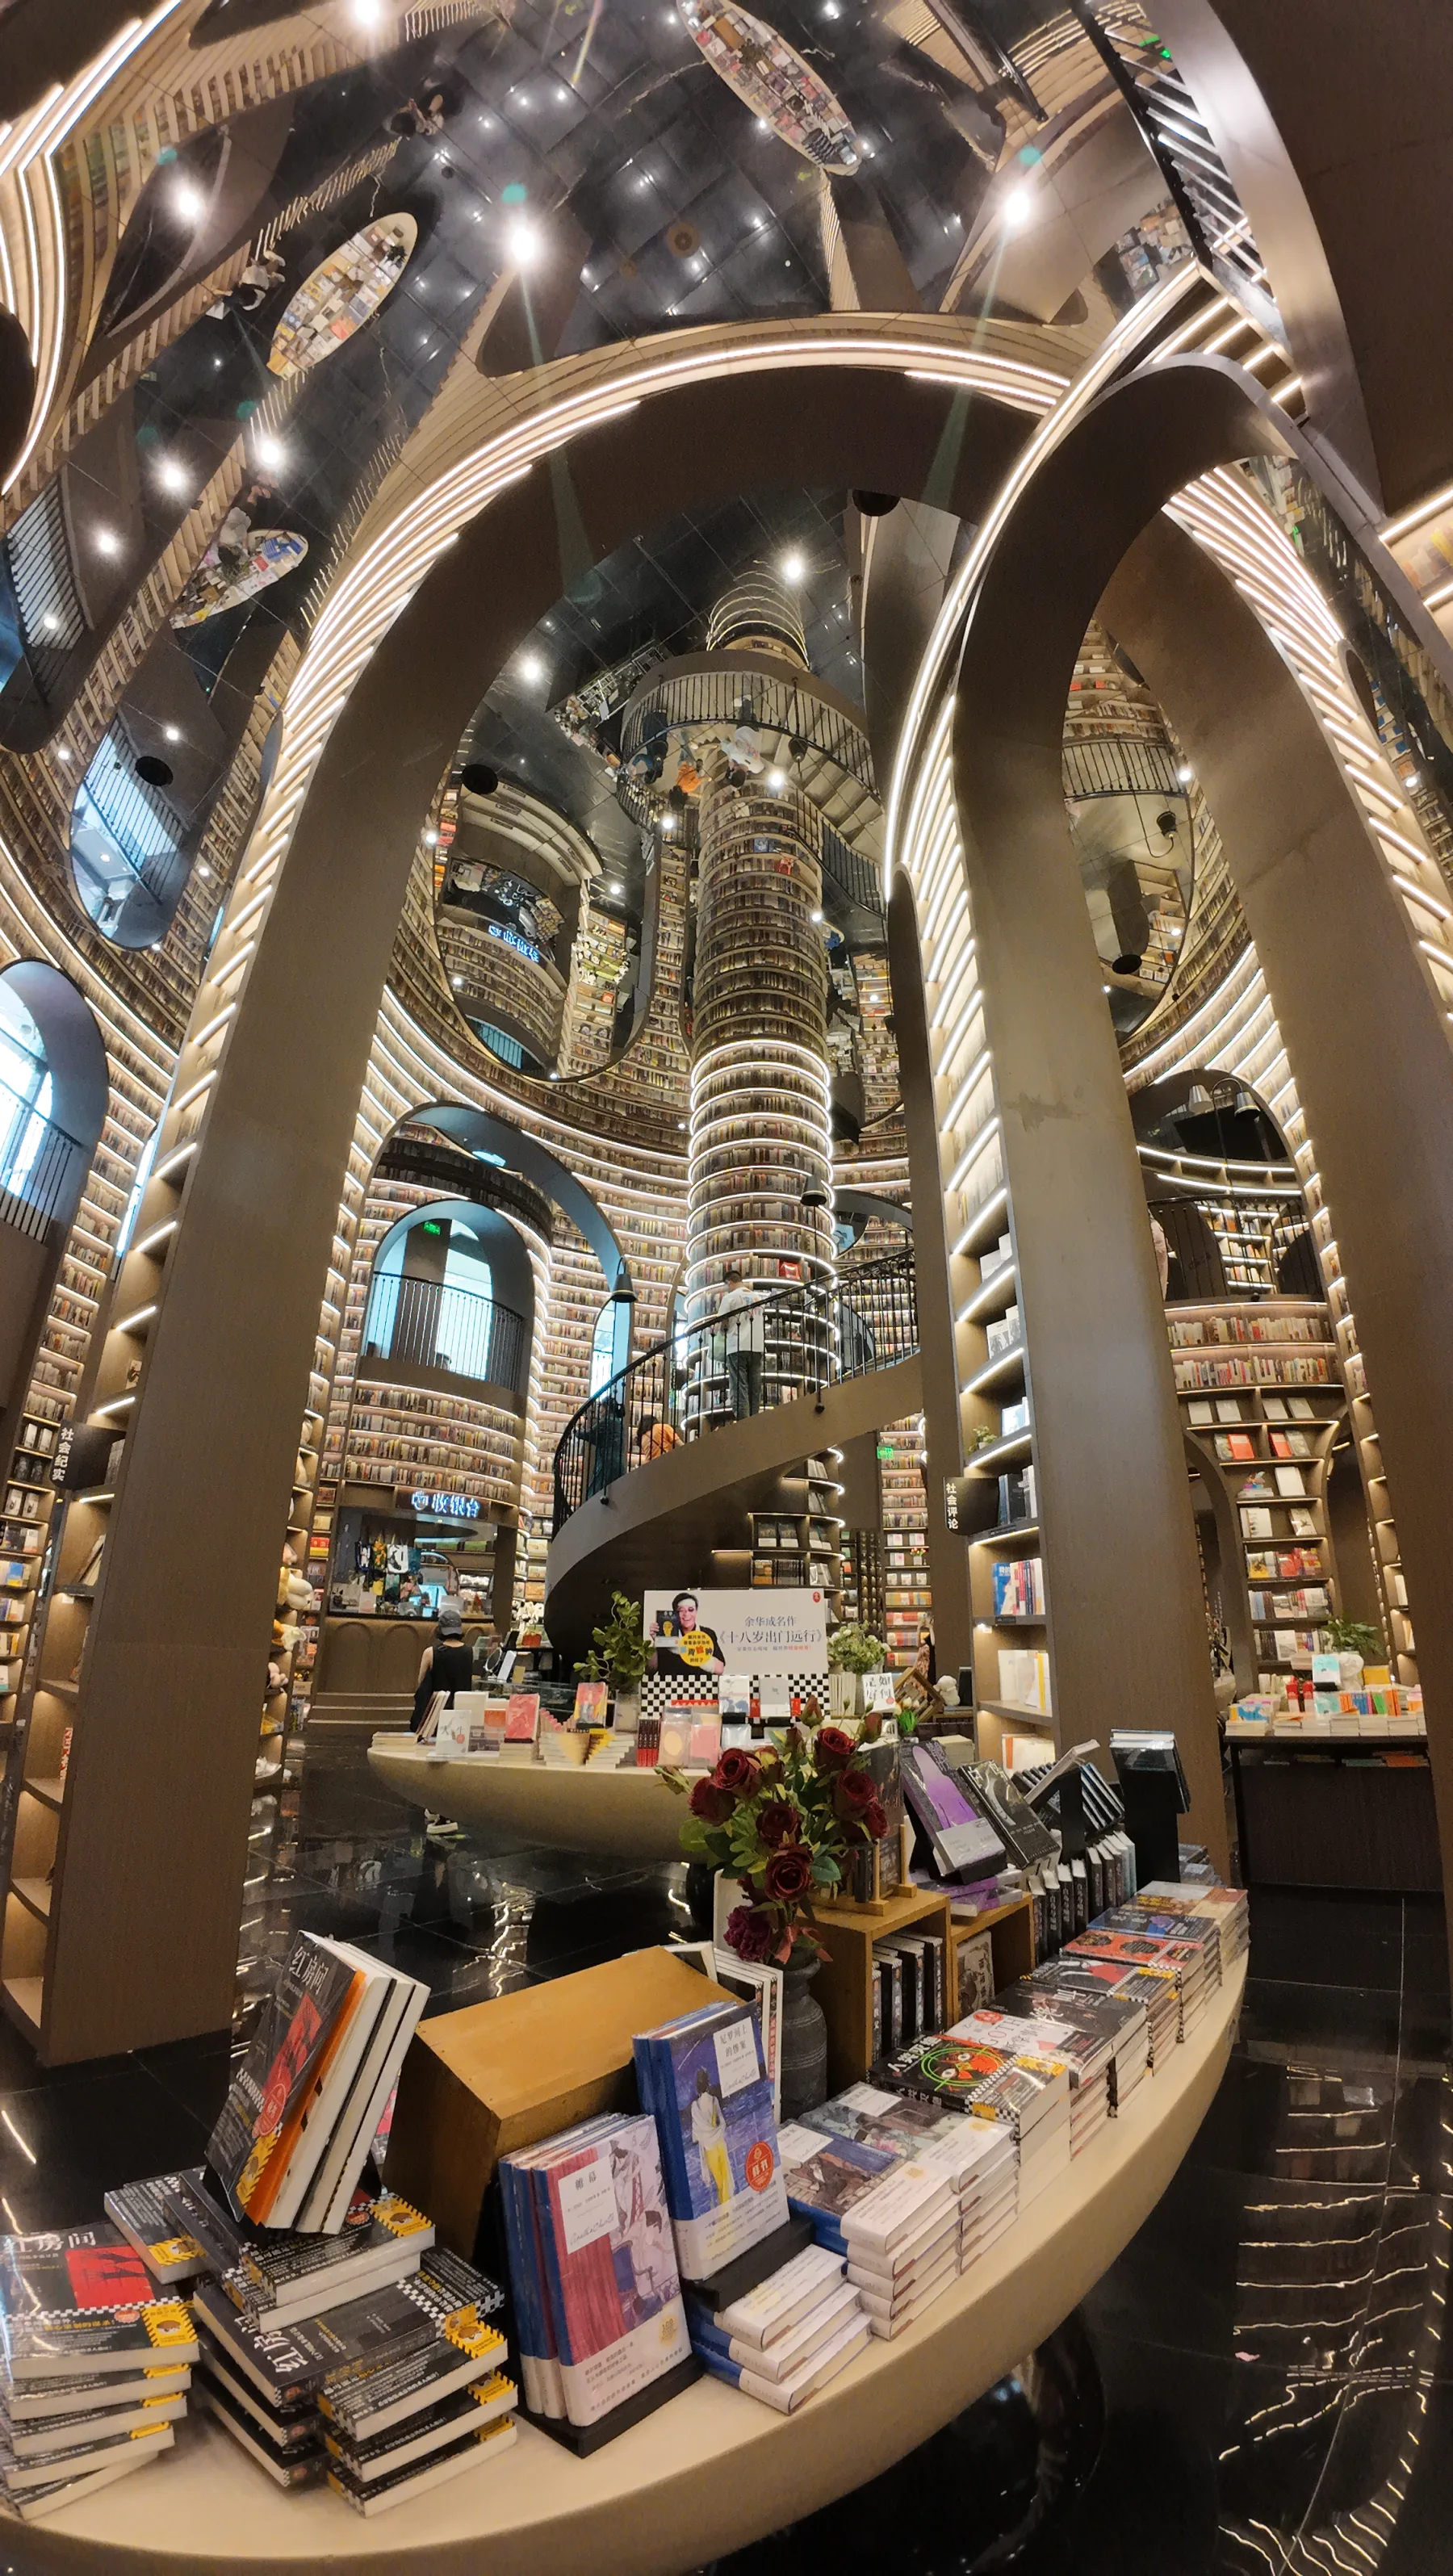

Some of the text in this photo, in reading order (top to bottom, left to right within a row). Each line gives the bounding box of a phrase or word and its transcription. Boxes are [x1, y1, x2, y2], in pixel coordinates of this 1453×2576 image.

[52, 1427, 74, 1481] 社会纪实
[431, 1492, 480, 1518] 收银台
[945, 1482, 959, 1530] 社会评论
[719, 1629, 823, 1644] 《十八岁出门远行》
[744, 1615, 796, 1627] 余华成名作
[289, 1946, 329, 1996] 红房间
[978, 2017, 1025, 2046] GOTH
[887, 2035, 943, 2072] 人类灭绝
